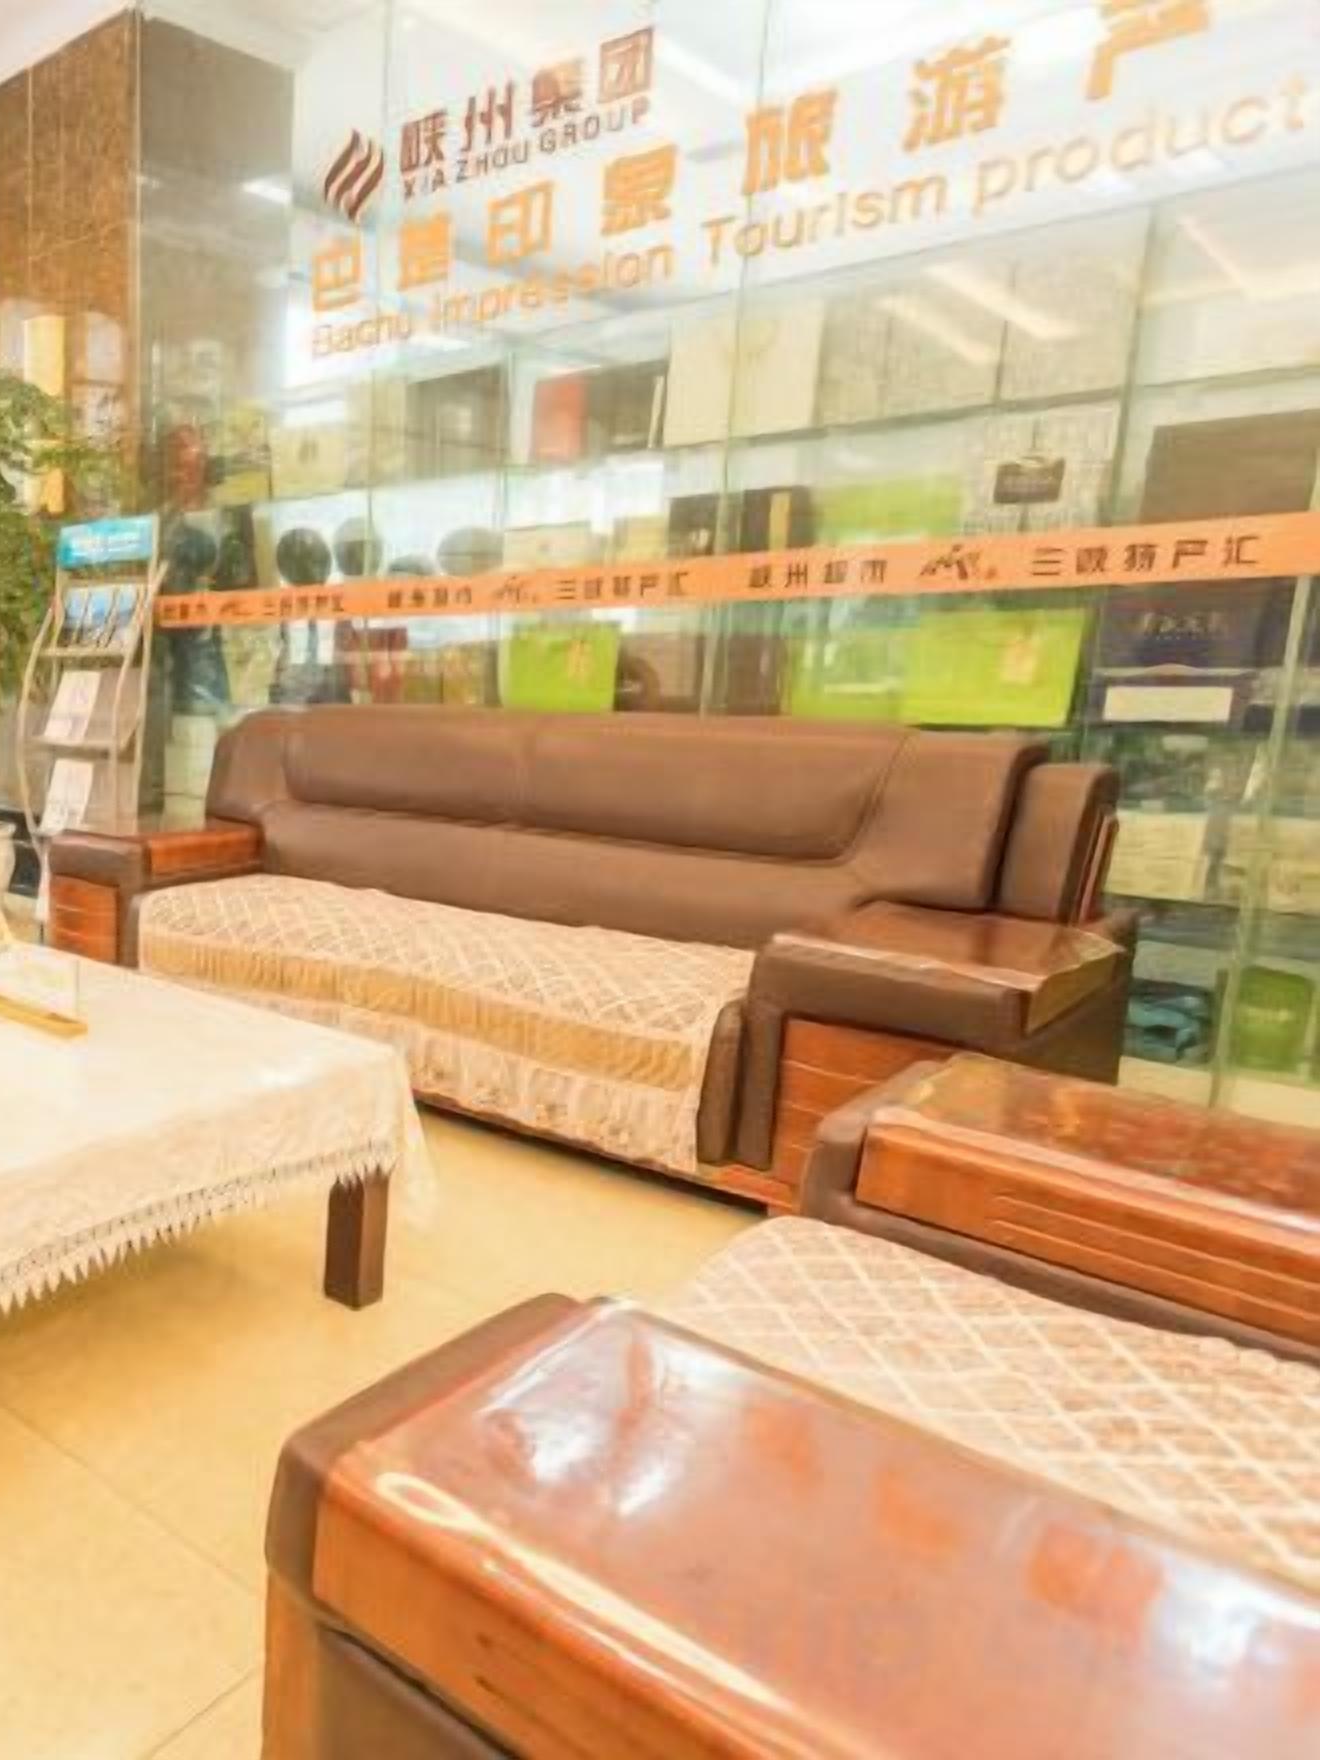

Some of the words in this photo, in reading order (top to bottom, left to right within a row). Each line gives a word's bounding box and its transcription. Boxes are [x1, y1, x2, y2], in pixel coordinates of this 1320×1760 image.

[539, 95, 652, 154] GROUP
[700, 174, 948, 267] Tourism
[972, 74, 1307, 218] product
[1031, 534, 1261, 577] 三峡特产汇
